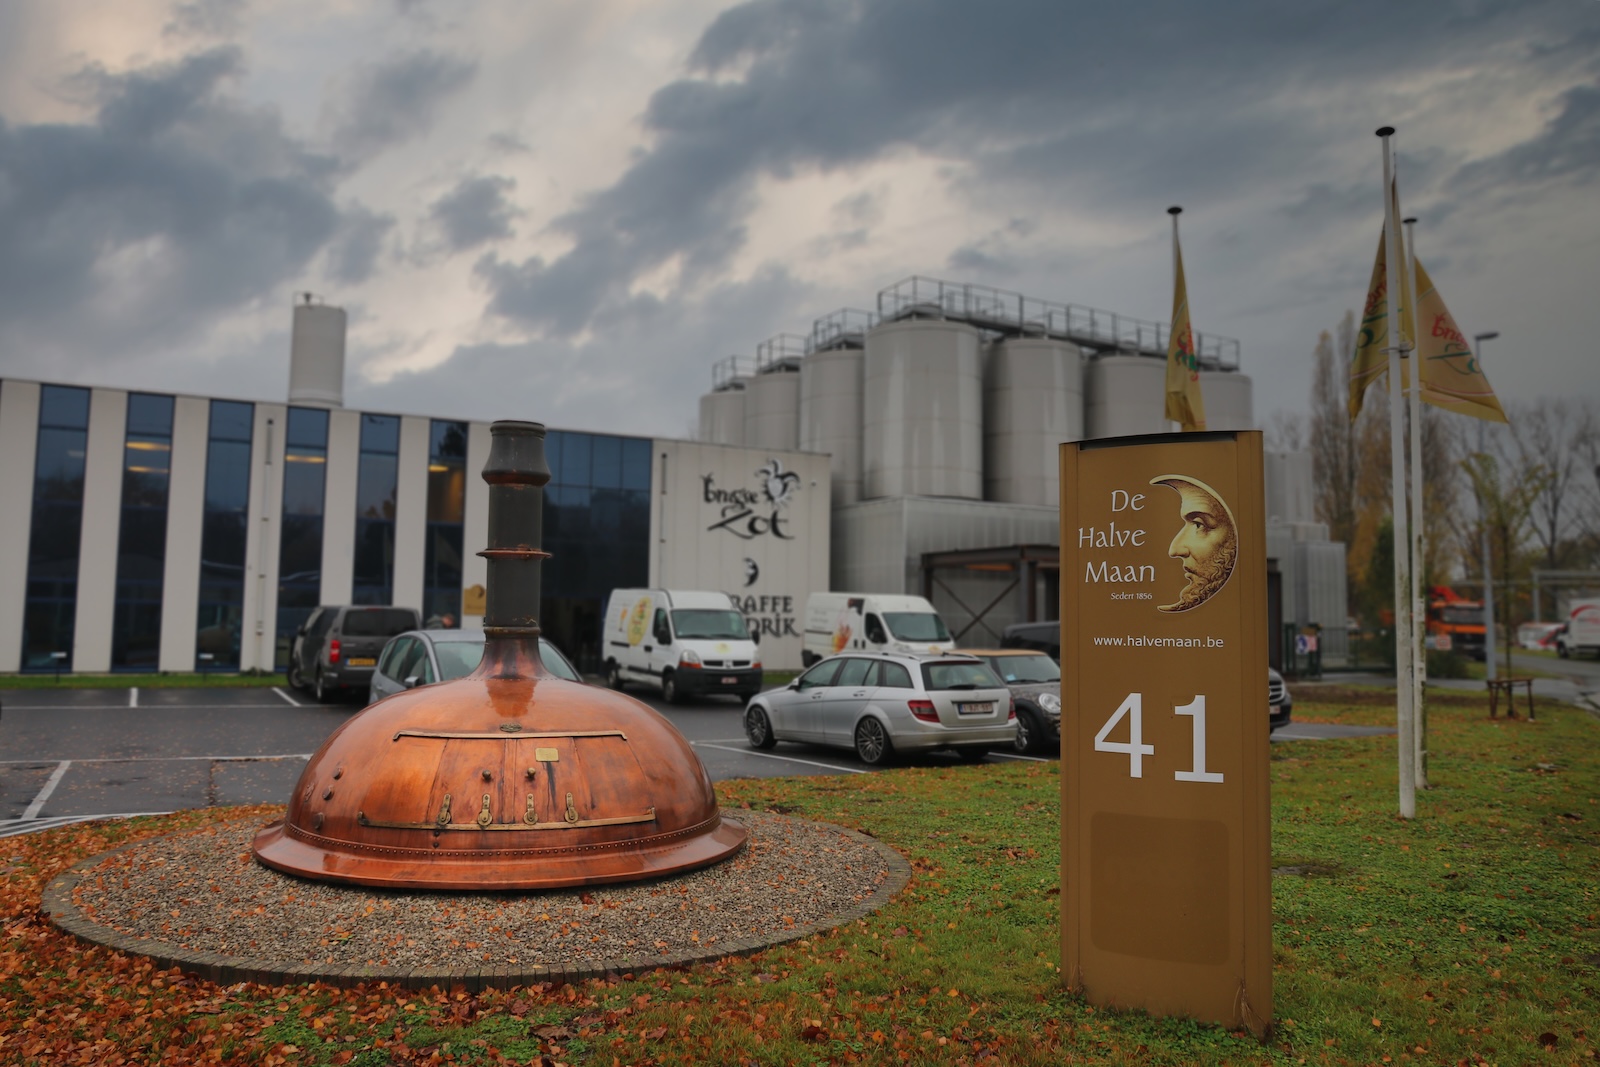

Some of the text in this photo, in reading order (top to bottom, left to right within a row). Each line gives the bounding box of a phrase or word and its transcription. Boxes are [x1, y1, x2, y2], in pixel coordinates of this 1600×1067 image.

[1110, 489, 1146, 513] De
[707, 504, 796, 540] Zot
[1078, 522, 1147, 549] Halve
[1084, 561, 1156, 584] Maan
[729, 594, 793, 615] RAFFE
[1110, 591, 1153, 600] Sedert 1856
[745, 612, 801, 638] DRIK
[1093, 635, 1224, 649] www.halvemaan.be
[1094, 692, 1224, 784] 41
